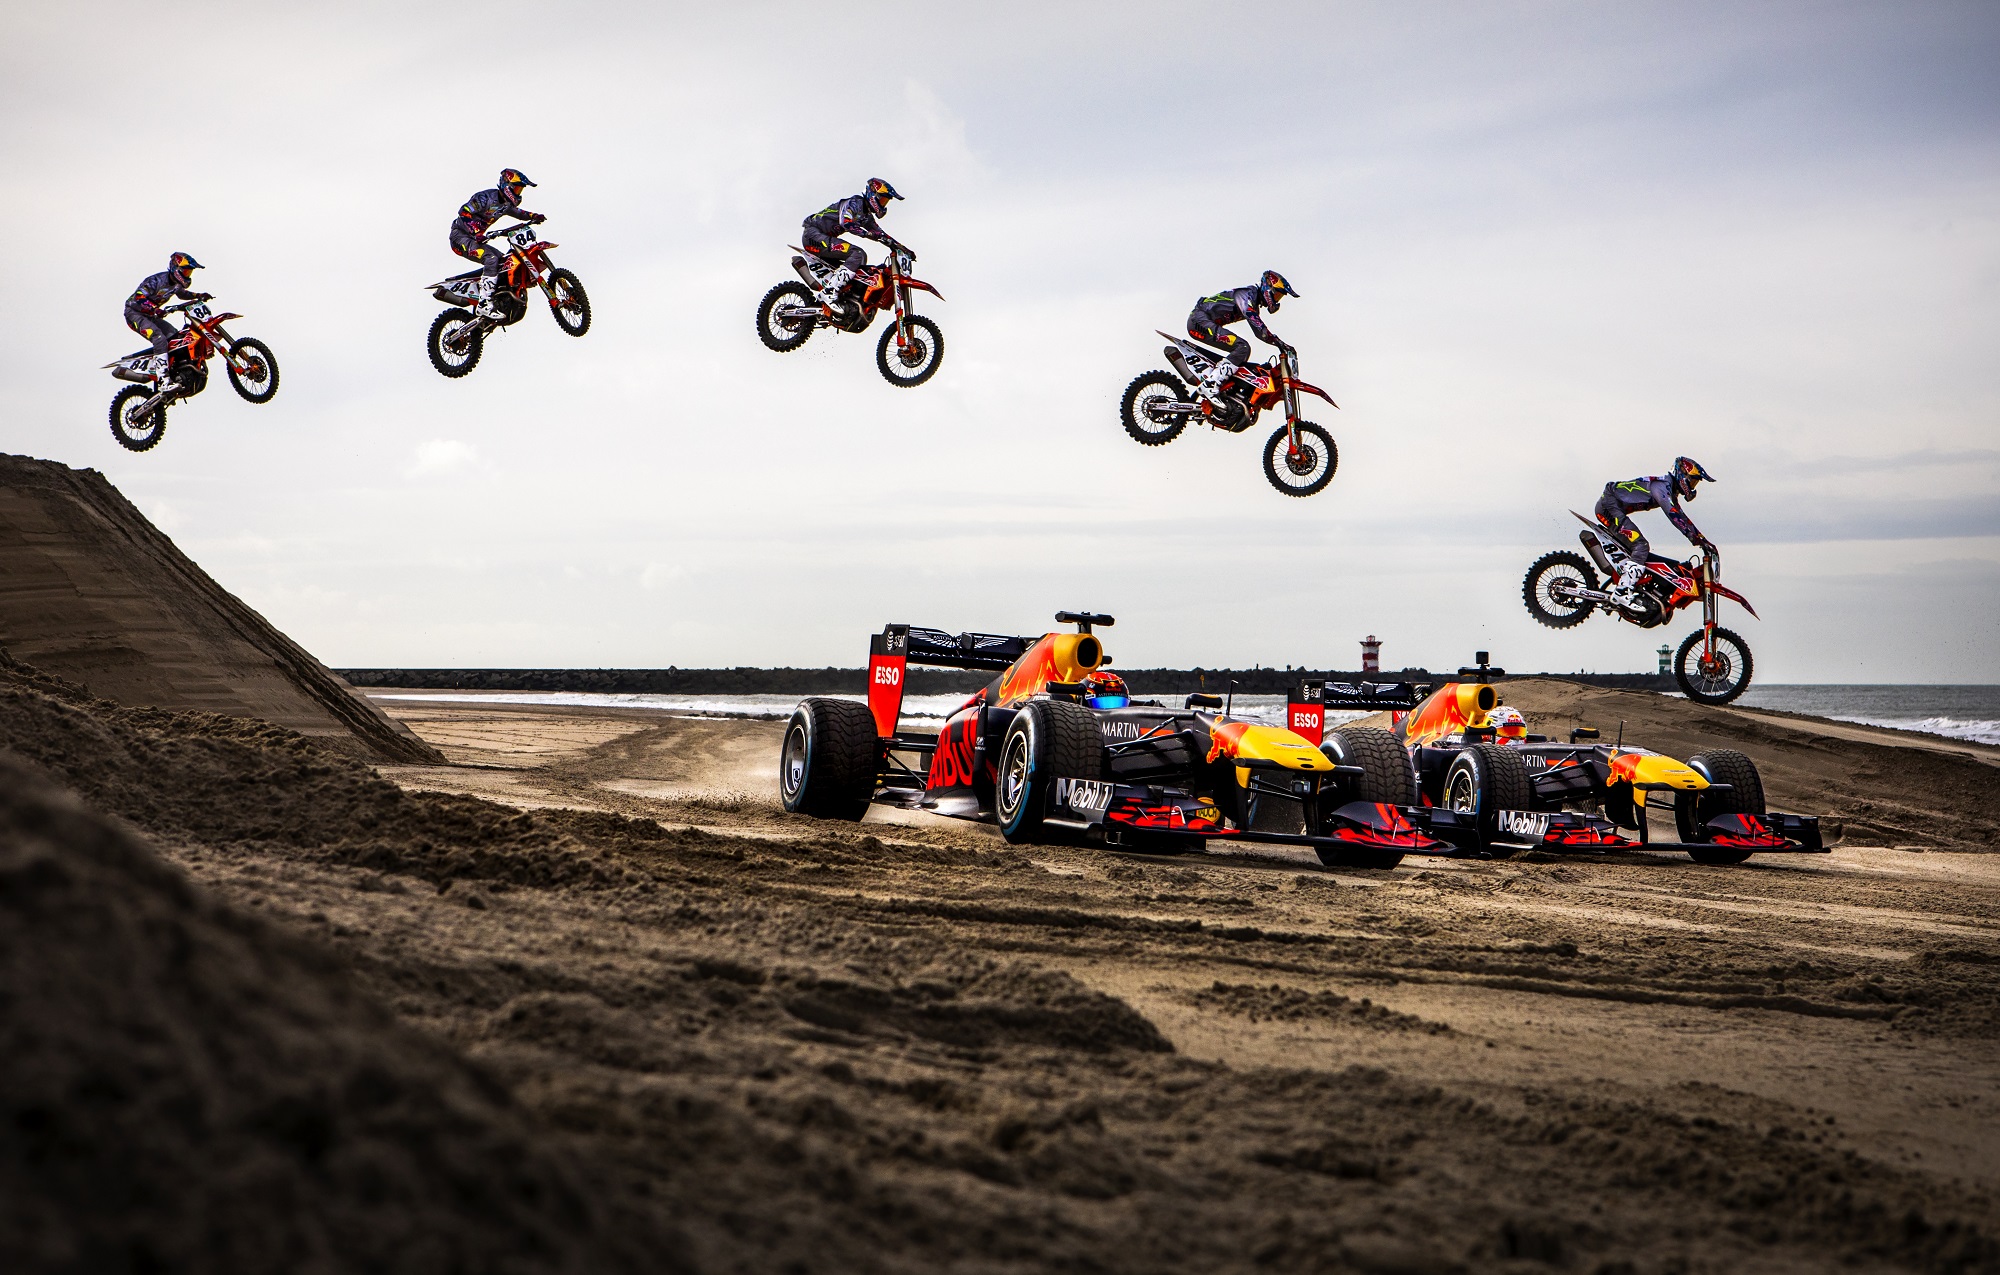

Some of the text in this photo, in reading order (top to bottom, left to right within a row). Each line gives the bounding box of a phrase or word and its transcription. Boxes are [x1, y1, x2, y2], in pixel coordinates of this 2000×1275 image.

[515, 229, 536, 246] 84
[809, 262, 831, 279] 84
[901, 257, 912, 275] 84
[450, 282, 470, 295] 84
[193, 304, 212, 319] 84
[129, 359, 150, 371] 84
[1185, 355, 1209, 374] 84
[1602, 543, 1628, 564] 84
[874, 665, 900, 686] ESSO
[1293, 712, 1319, 729] ESSO
[1101, 721, 1140, 739] MARTIN
[1055, 777, 1100, 810] Mobil
[1498, 809, 1537, 834] Mobil
